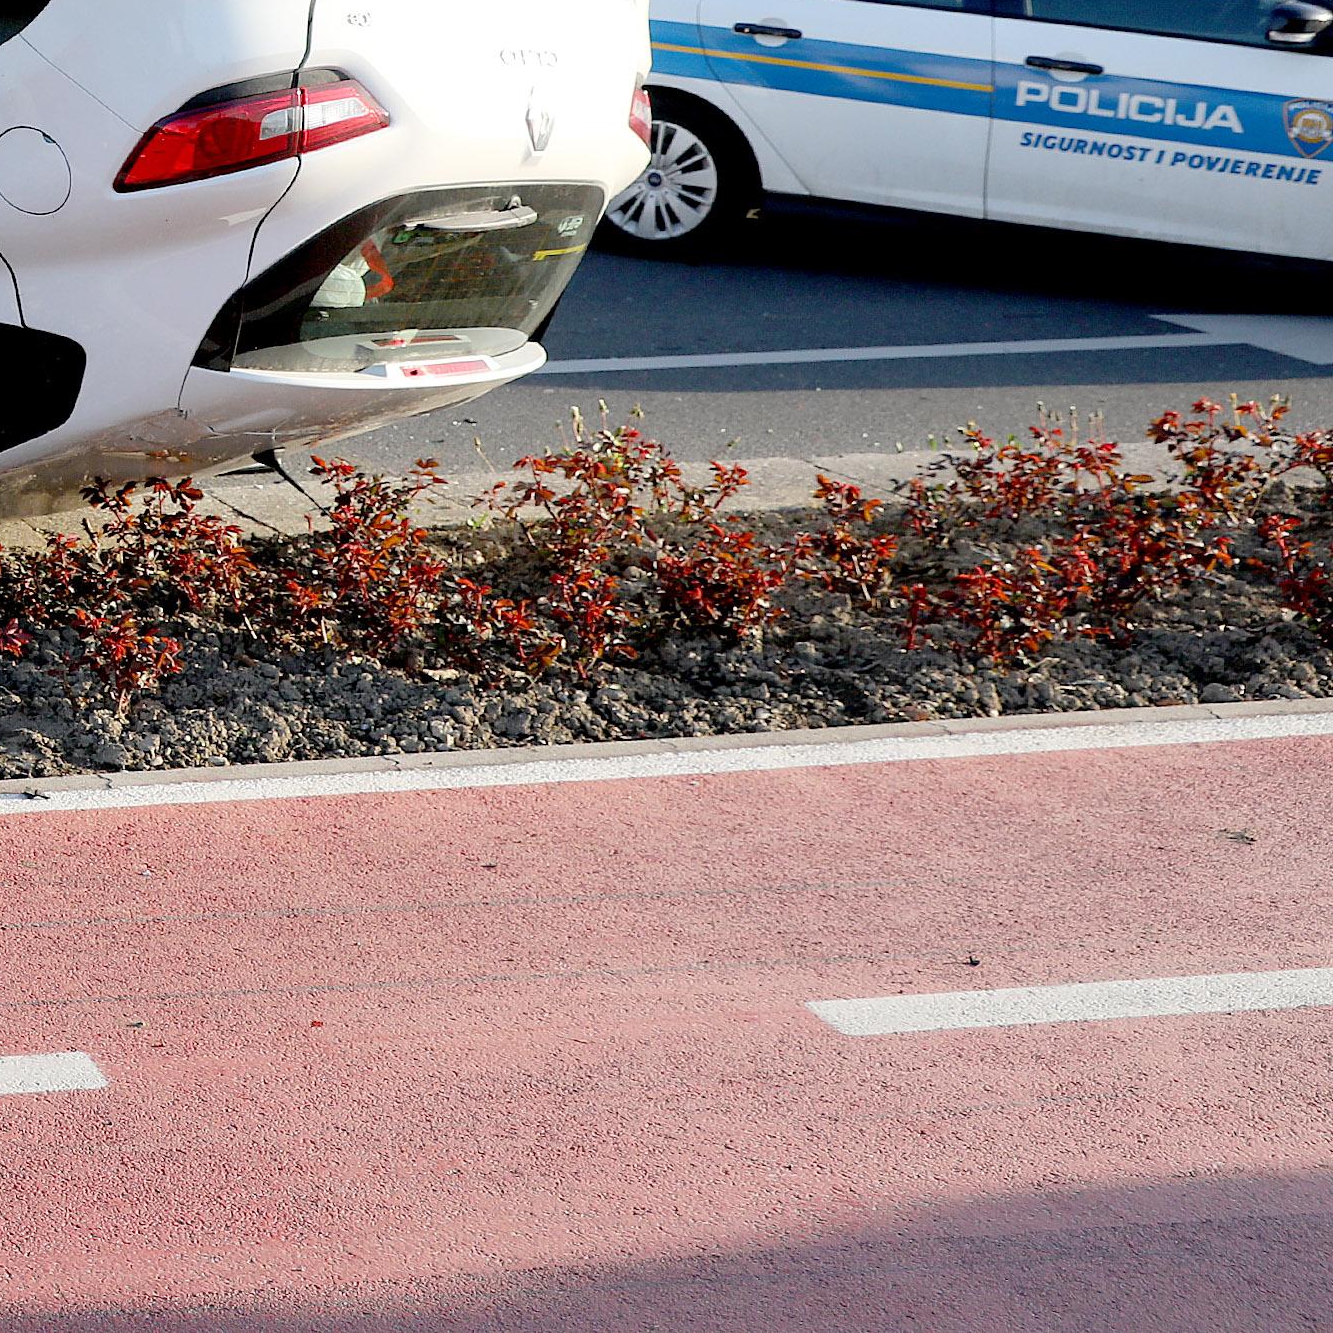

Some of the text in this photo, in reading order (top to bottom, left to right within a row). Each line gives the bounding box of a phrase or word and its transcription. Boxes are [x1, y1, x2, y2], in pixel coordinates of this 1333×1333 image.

[1015, 80, 1244, 134] POLICIJA
[1020, 131, 1323, 185] SIGURNOST I POVJERENJE
